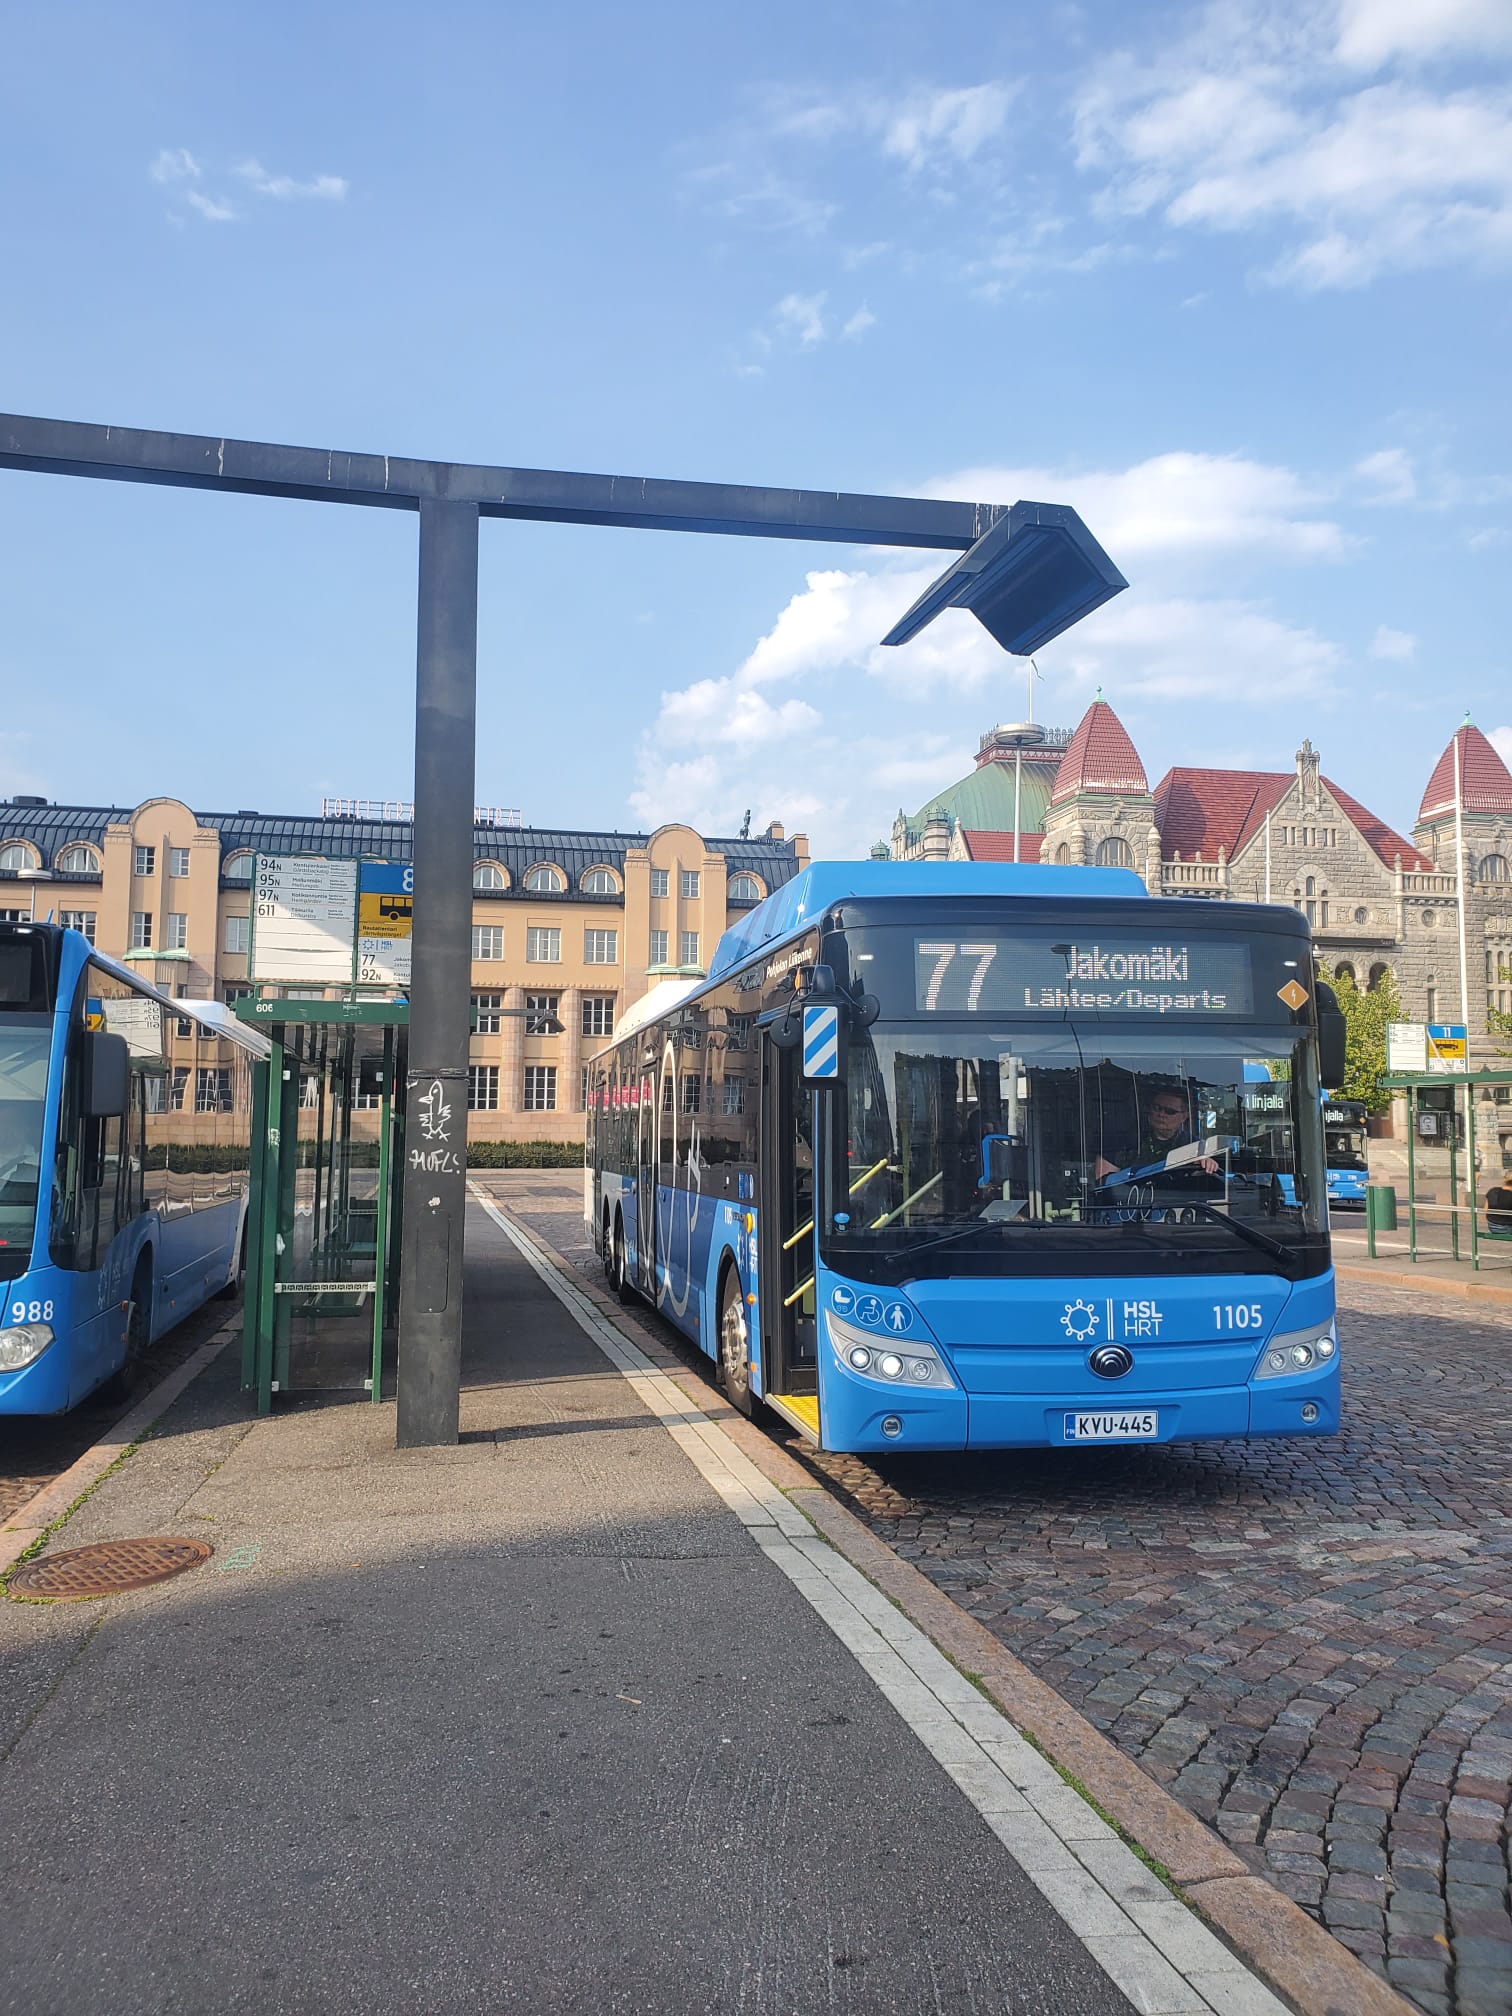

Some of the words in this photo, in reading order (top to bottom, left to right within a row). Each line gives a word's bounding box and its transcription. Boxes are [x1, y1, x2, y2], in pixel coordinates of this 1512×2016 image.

[322, 798, 371, 819] HOTEL
[384, 801, 415, 821] GRA
[474, 807, 525, 828] NTRAL
[260, 858, 282, 871] 94N
[260, 873, 280, 886] 95N
[402, 868, 414, 892] 8
[259, 889, 279, 901] 97N
[258, 904, 275, 916] 611
[362, 954, 376, 966] 77
[1065, 945, 1188, 981] Jakomäki
[361, 968, 381, 981] 92N
[918, 943, 997, 1011] 77
[256, 1003, 273, 1013] 606
[1023, 987, 1227, 1013] Lähtee/Departs
[1442, 1027, 1451, 1038] 11
[1251, 1094, 1284, 1112] linjalla
[12, 1299, 54, 1323] 988
[1123, 1300, 1164, 1319] HSL
[1212, 1304, 1263, 1330] 1105
[1123, 1319, 1164, 1337] HRT
[1079, 1415, 1154, 1435] KVU-445
